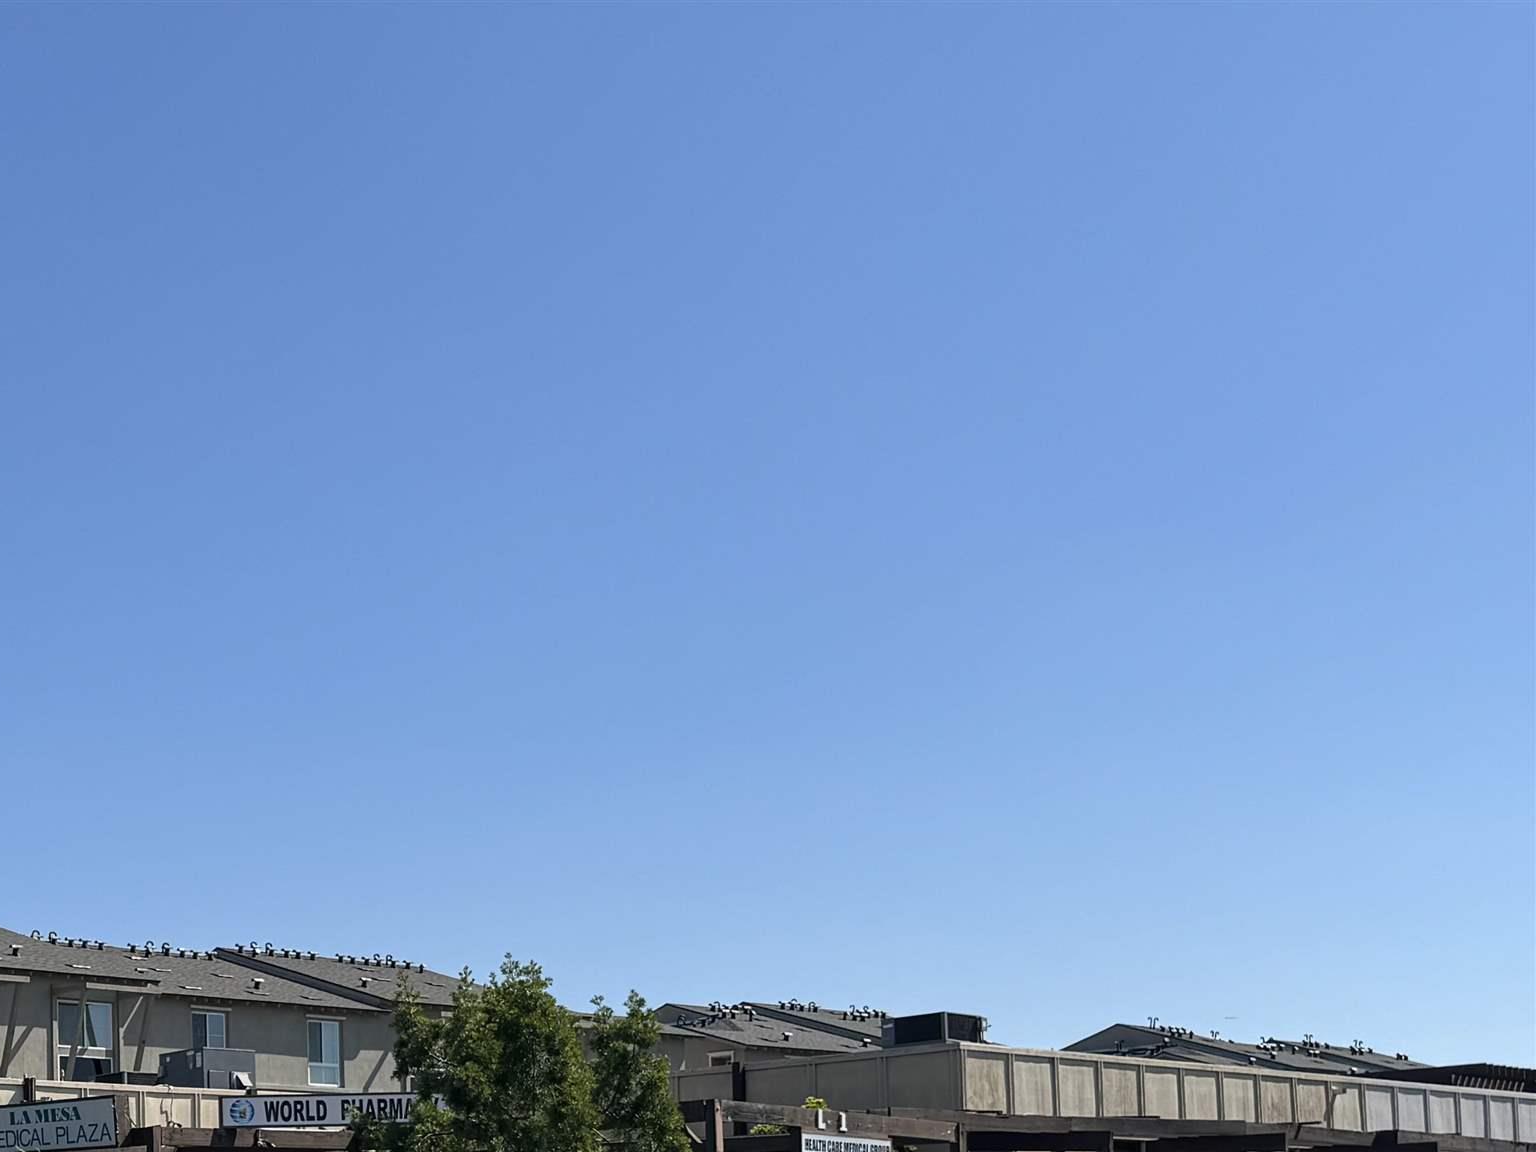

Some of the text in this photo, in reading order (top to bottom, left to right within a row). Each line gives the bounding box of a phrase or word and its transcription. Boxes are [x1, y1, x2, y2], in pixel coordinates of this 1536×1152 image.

[9, 1106, 82, 1126] LA MESA
[264, 1100, 328, 1122] WORLD
[56, 1123, 112, 1145] PLAZA
[804, 1138, 827, 1152] HEALTH
